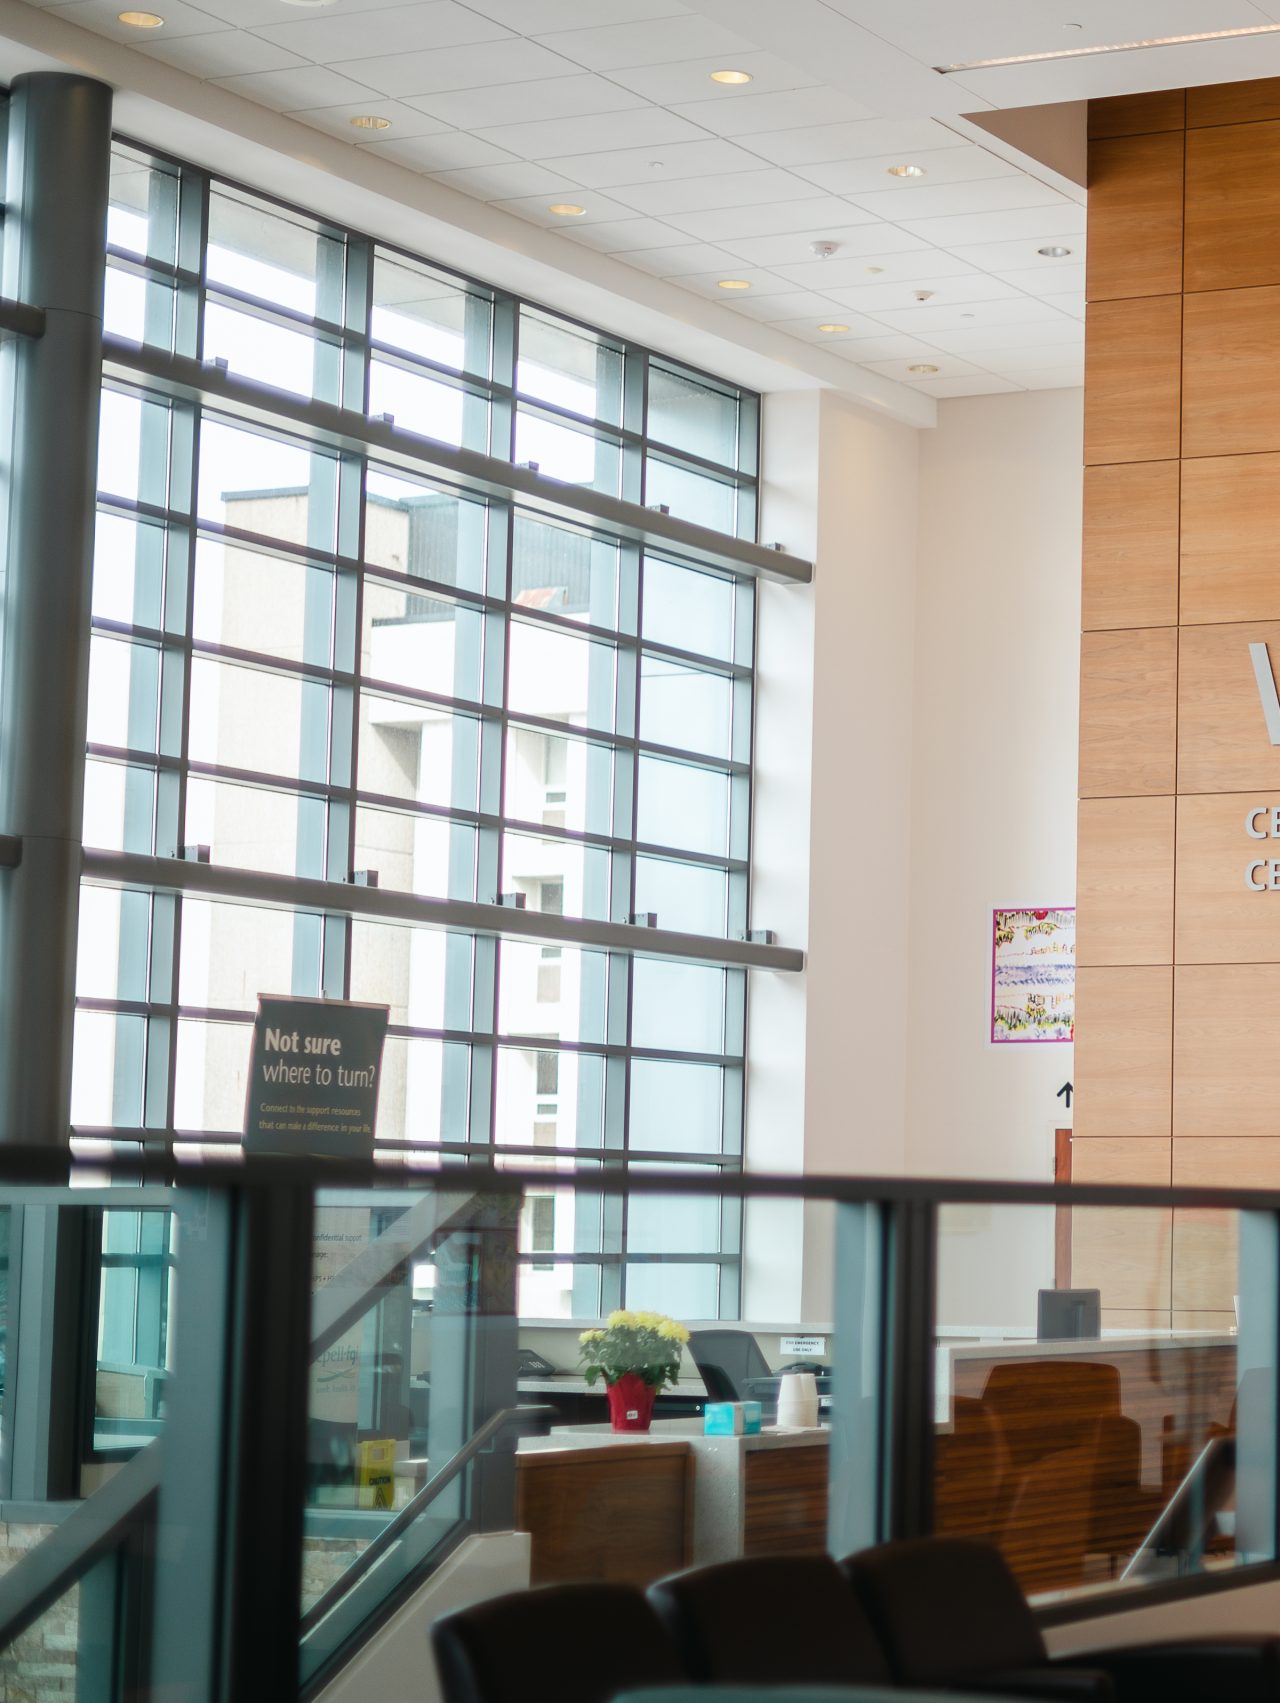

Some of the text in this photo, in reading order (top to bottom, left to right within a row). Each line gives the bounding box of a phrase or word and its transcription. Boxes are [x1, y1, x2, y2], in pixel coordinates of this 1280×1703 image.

[265, 1027, 341, 1055] Not sure
[263, 1058, 375, 1088] where to turn?
[260, 1102, 288, 1113] Connect
[306, 1105, 330, 1117] support
[259, 1120, 274, 1130] that
[307, 1121, 340, 1133] difference
